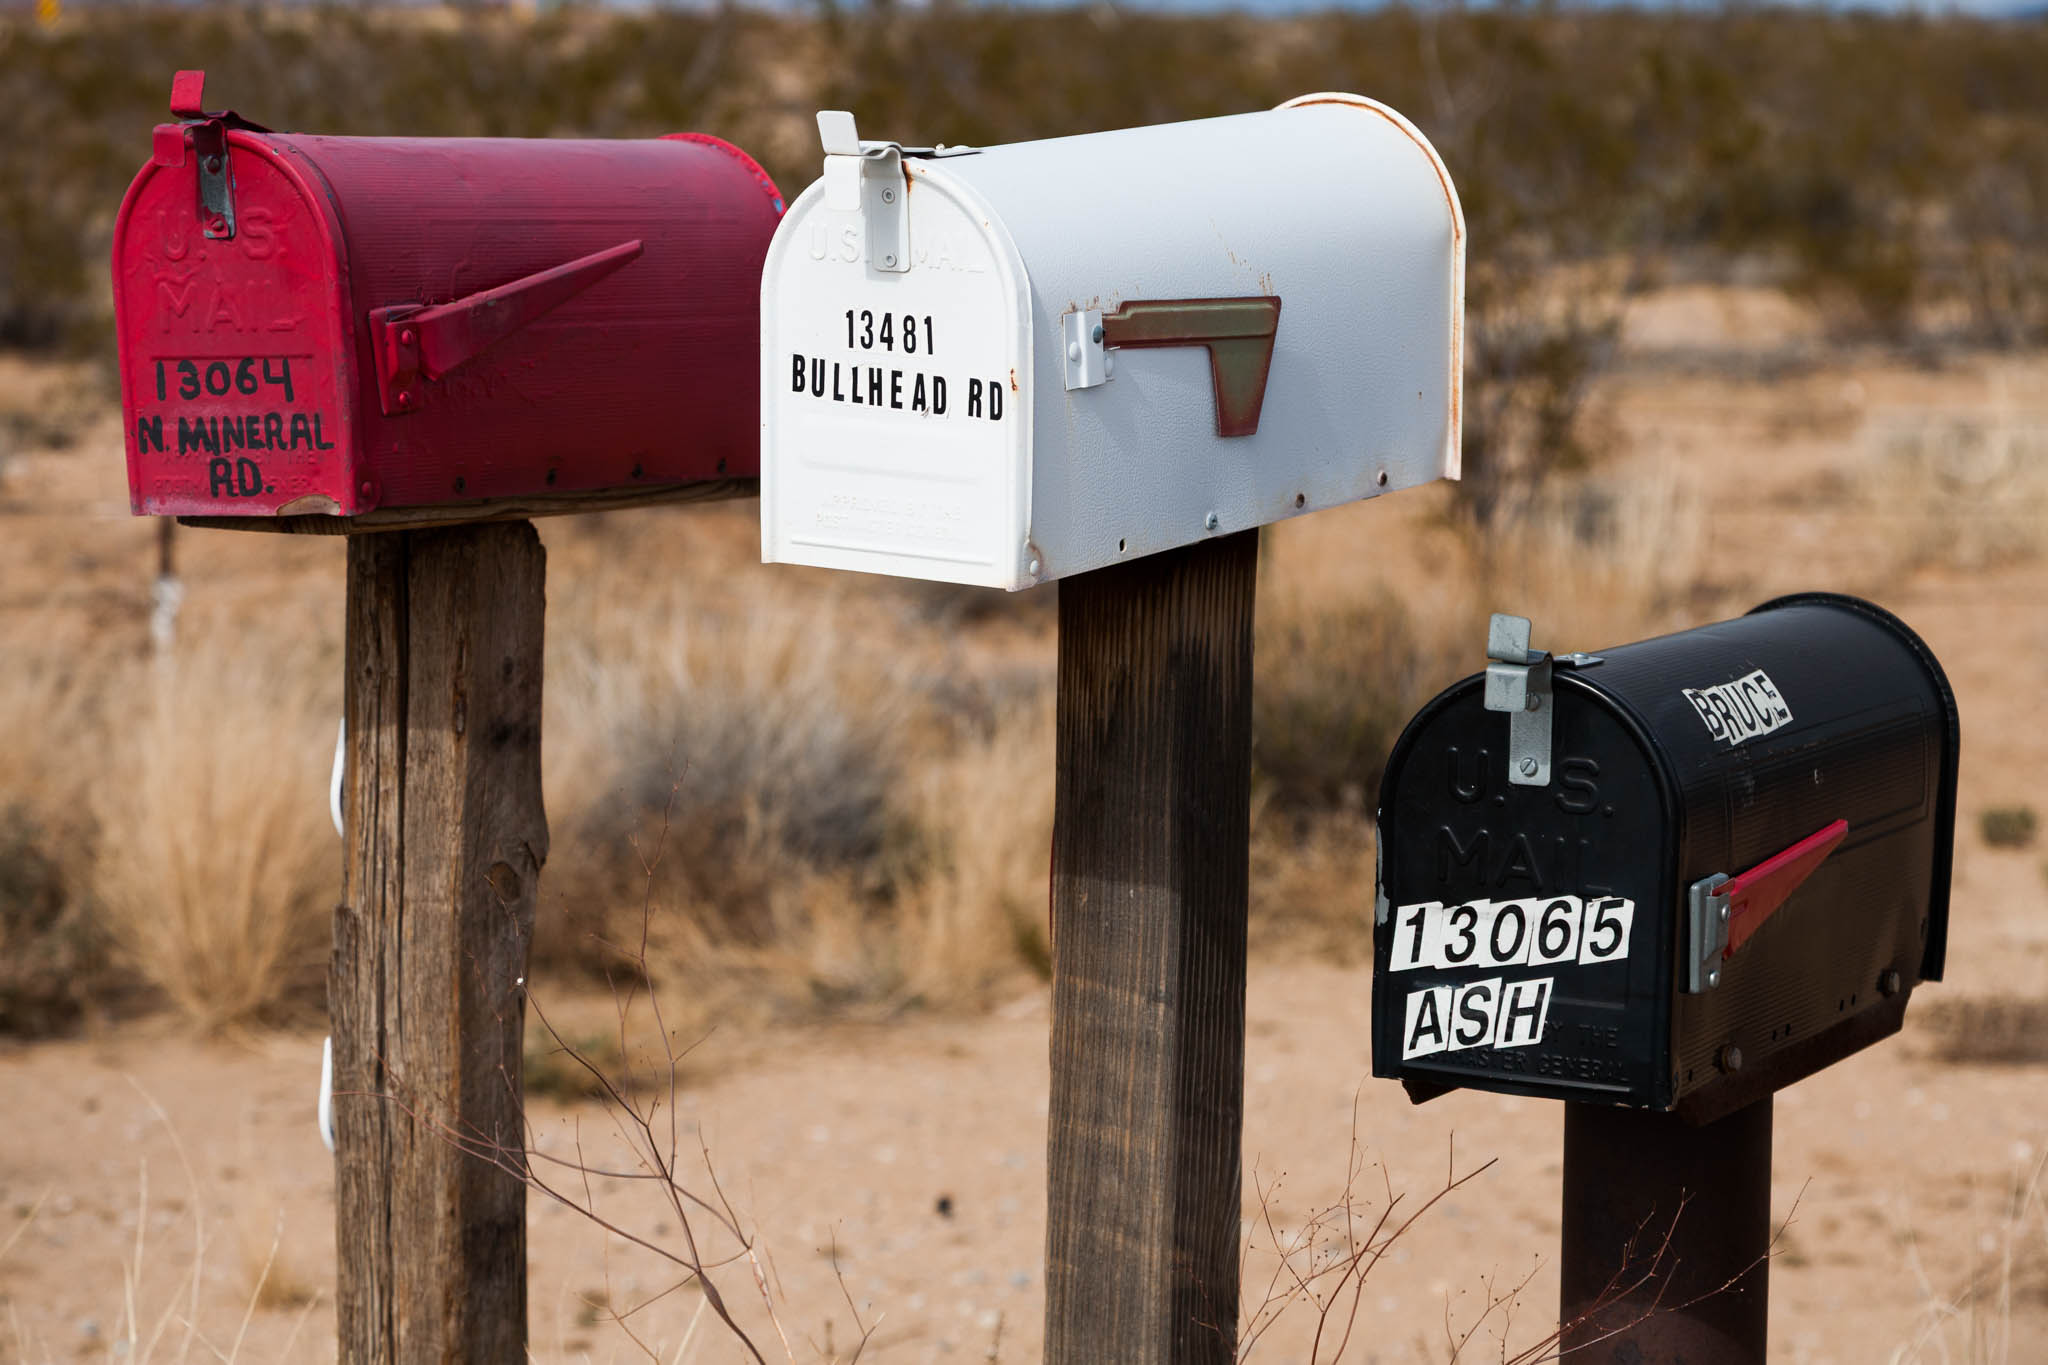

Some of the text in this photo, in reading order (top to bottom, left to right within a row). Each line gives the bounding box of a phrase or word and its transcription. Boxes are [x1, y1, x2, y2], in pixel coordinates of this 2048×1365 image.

[157, 279, 299, 334] MAIL
[845, 309, 934, 356] 13481
[155, 356, 296, 403] 13064
[791, 353, 1004, 422] BULLHEAD RD
[138, 411, 336, 458] N. MINERAL
[209, 456, 276, 499] RD.
[1688, 674, 1790, 741] BRUCE
[1437, 823, 1615, 893] MAIL
[1404, 898, 1627, 964] 13065
[1408, 982, 1547, 1052] ASH
[1577, 1023, 1619, 1049] THE
[1536, 1052, 1630, 1082] GENERAL
